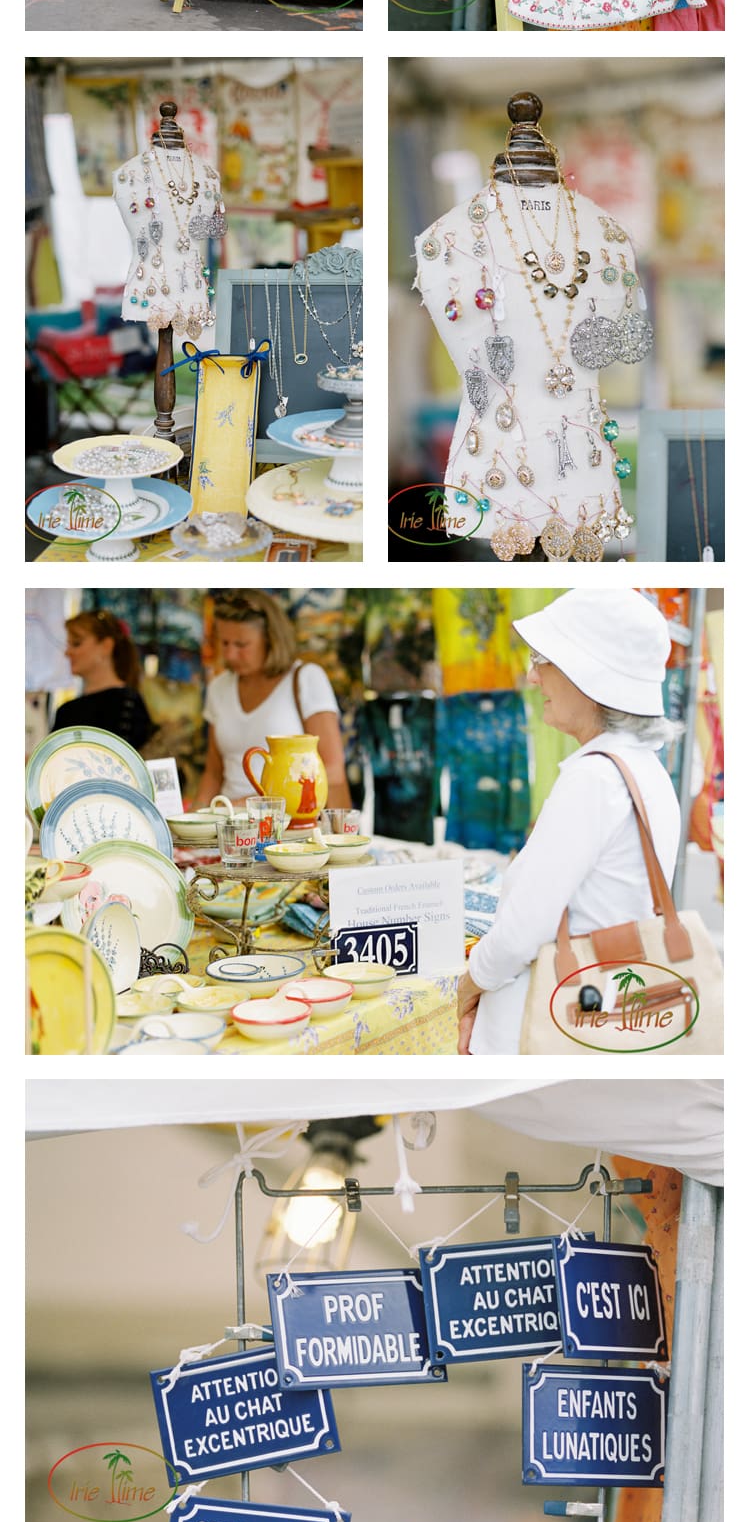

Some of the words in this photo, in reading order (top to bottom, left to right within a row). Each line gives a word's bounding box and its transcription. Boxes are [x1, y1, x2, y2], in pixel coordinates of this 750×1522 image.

[520, 199, 552, 211] PARIS
[236, 834, 256, 847] bon
[423, 910, 451, 924] Signs
[344, 931, 408, 966] 3405
[459, 1259, 555, 1286] ATTENTIO
[323, 1292, 384, 1324] PROF
[473, 1290, 499, 1311] AU
[504, 1285, 555, 1309] CHAT
[576, 1282, 621, 1321] C'EST
[628, 1283, 651, 1321] ICI
[449, 1310, 560, 1340] EXCENTRIQ
[296, 1332, 424, 1368] FORMIDABLE
[191, 1367, 278, 1403] ATTENTIO
[205, 1406, 230, 1427] AU
[234, 1393, 283, 1421] CHAT
[557, 1388, 637, 1420] ENFANTS
[184, 1413, 315, 1458] EXCENTRIQUE
[542, 1431, 653, 1463] LUNATIQUES
